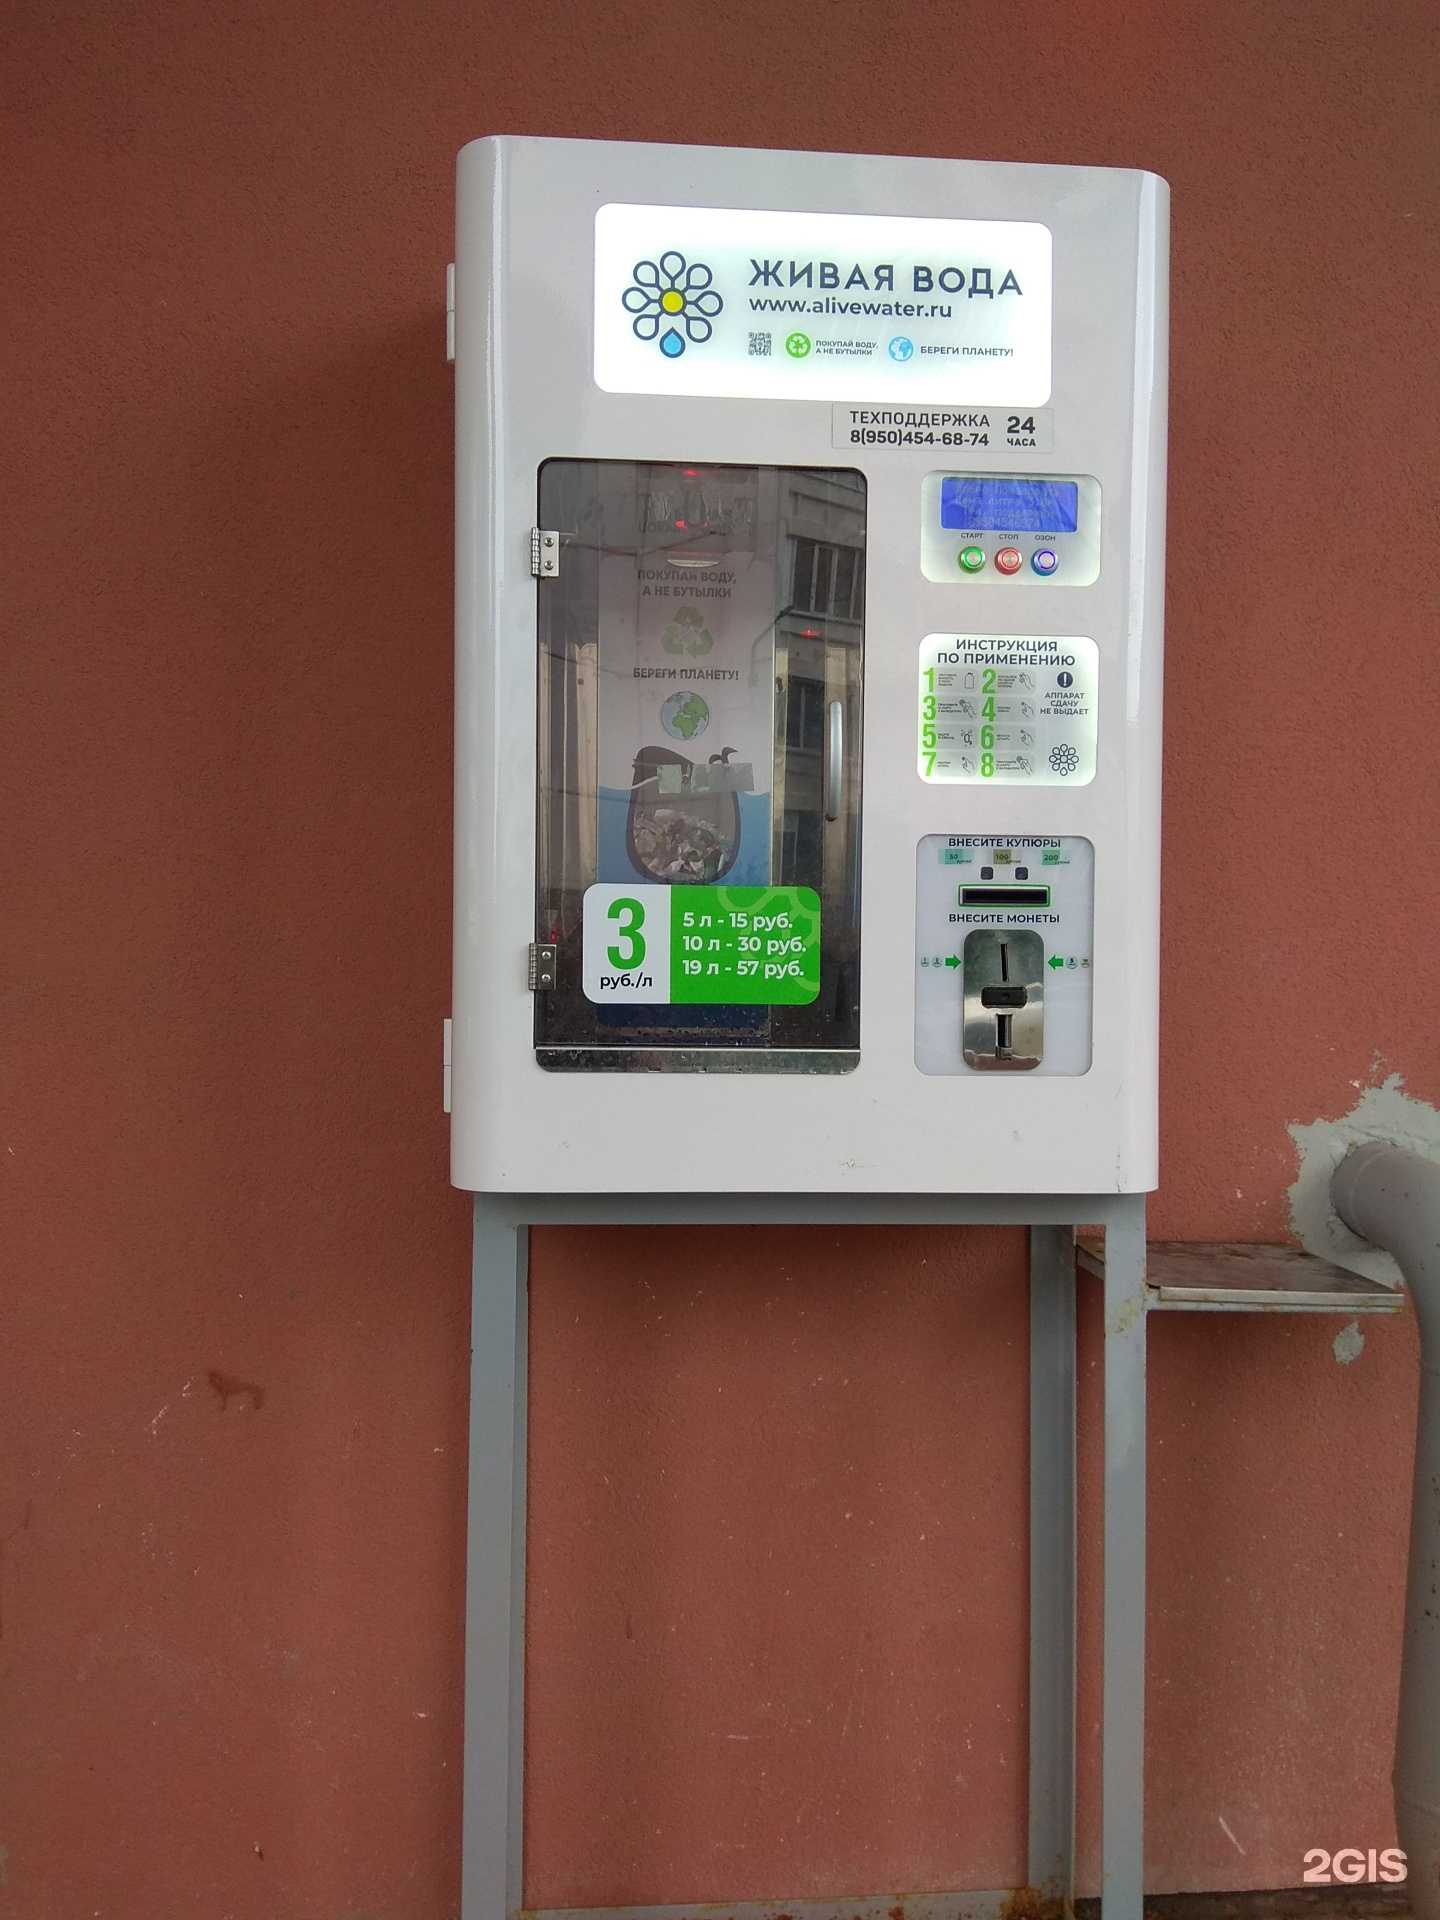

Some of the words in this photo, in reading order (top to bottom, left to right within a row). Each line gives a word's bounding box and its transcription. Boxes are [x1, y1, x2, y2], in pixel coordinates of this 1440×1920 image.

[749, 259, 895, 292] ЖИВАЯ
[913, 265, 1024, 299] ВОДА
[749, 297, 952, 318] www.alivewater.ru
[815, 340, 854, 348] ПОКУПАЙ
[920, 345, 960, 355] БЕРЕГИ
[962, 347, 1014, 357] ПЛАНЕТУ!
[850, 410, 990, 428] ТЕХПОДДЕРЖКА
[1006, 415, 1036, 434] 24
[850, 428, 990, 446] 8(950)454-68-74
[1007, 438, 1037, 447] ЧАСА
[961, 532, 984, 540] СТАРТ
[642, 586, 651, 596] А
[654, 586, 671, 597] НЕ
[673, 587, 732, 598] БУТЫЛКИ
[956, 639, 1058, 653] ИНСТРУКЦИЯ
[937, 653, 960, 664] ПО
[964, 653, 1076, 666] ПРИМЕНЕНИЮ
[633, 667, 677, 679] БЕРЕГИ
[680, 668, 739, 681] ПЛАНЕТУ!
[922, 668, 935, 692] 1
[981, 668, 997, 694] 2
[922, 696, 937, 721] 3
[981, 696, 996, 722] 4
[1040, 707, 1052, 715] НЕ
[1054, 708, 1089, 716] ВЫДАЕТ
[1051, 700, 1078, 708] СДАЧУ
[922, 724, 937, 748] 5
[980, 725, 995, 749] 6
[922, 752, 937, 776] 7
[980, 752, 995, 777] 8
[948, 838, 1002, 847] ВНЕСИТЕ
[1005, 838, 1061, 848] КУПЮРЫ
[683, 913, 694, 928] 5
[699, 916, 712, 928] л
[729, 913, 748, 928] 15
[753, 913, 793, 933] руб.
[948, 914, 1003, 923] ВНЕСИТЕ
[1006, 914, 1060, 923] МОНЕТЫ
[607, 898, 646, 970] 3
[682, 937, 702, 951] 10
[707, 939, 720, 952] л
[737, 937, 761, 952] 30
[767, 936, 807, 957] руб.
[682, 960, 702, 975] 19
[706, 963, 719, 975] л
[736, 960, 759, 976] 57
[764, 960, 804, 980] руб.
[600, 973, 653, 989] руб./л
